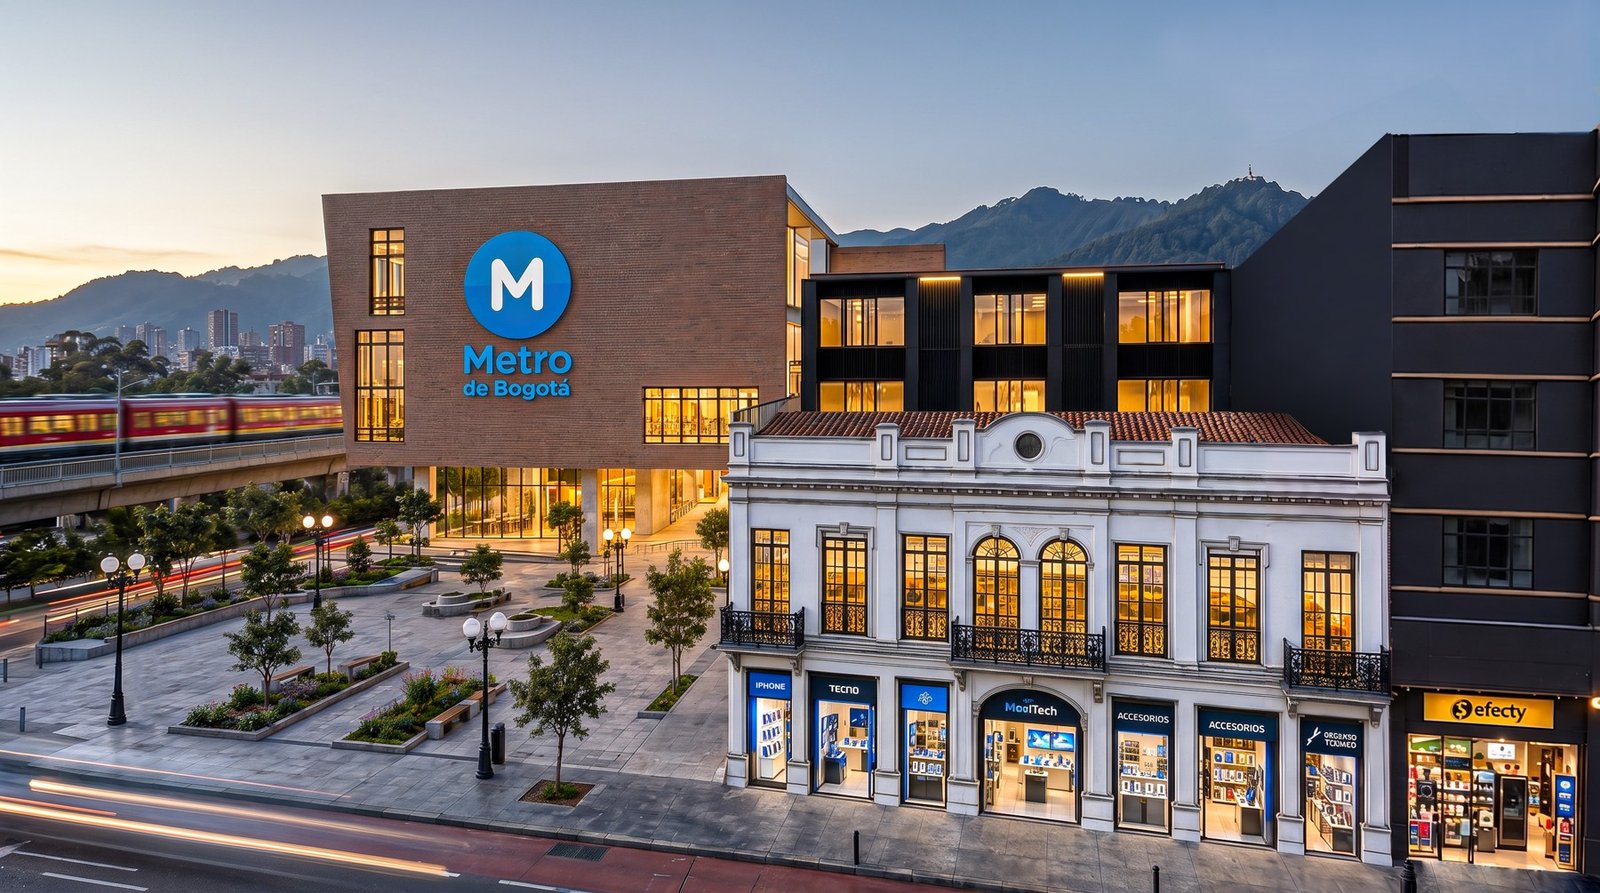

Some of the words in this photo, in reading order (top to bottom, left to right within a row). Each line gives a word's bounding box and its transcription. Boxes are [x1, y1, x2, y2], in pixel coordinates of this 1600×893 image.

[491, 257, 544, 312] M
[463, 344, 573, 375] Metro
[463, 379, 489, 397] de
[494, 378, 571, 401] Bogotá
[755, 681, 786, 691] IPHONE
[1117, 712, 1170, 724] ACCESORIOS
[1474, 701, 1527, 723] efecty
[1208, 721, 1265, 734] ACCESORIOS
